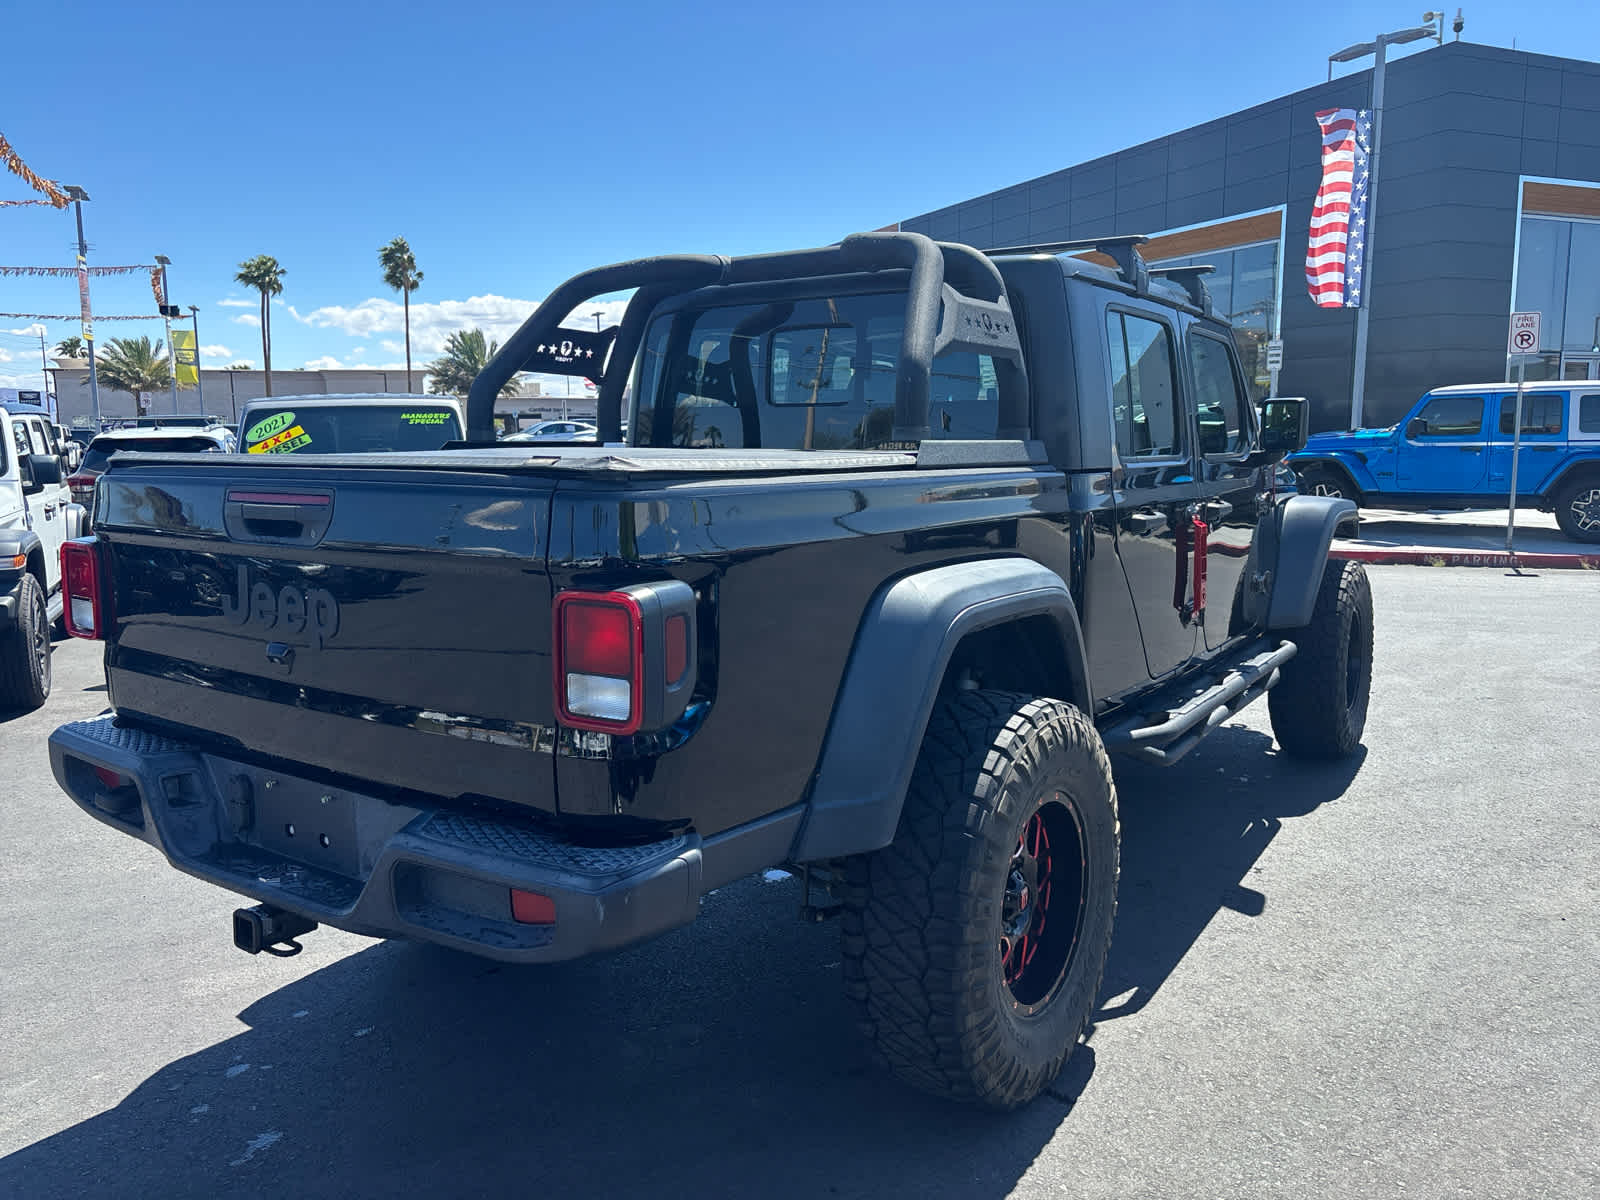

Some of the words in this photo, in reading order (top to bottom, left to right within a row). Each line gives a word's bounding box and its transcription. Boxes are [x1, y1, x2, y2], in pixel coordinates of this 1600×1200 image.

[255, 415, 287, 439] 2021
[261, 441, 270, 450] 4
[284, 431, 292, 440] 4
[1451, 555, 1518, 569] PARKING
[220, 564, 339, 650] Jeep
